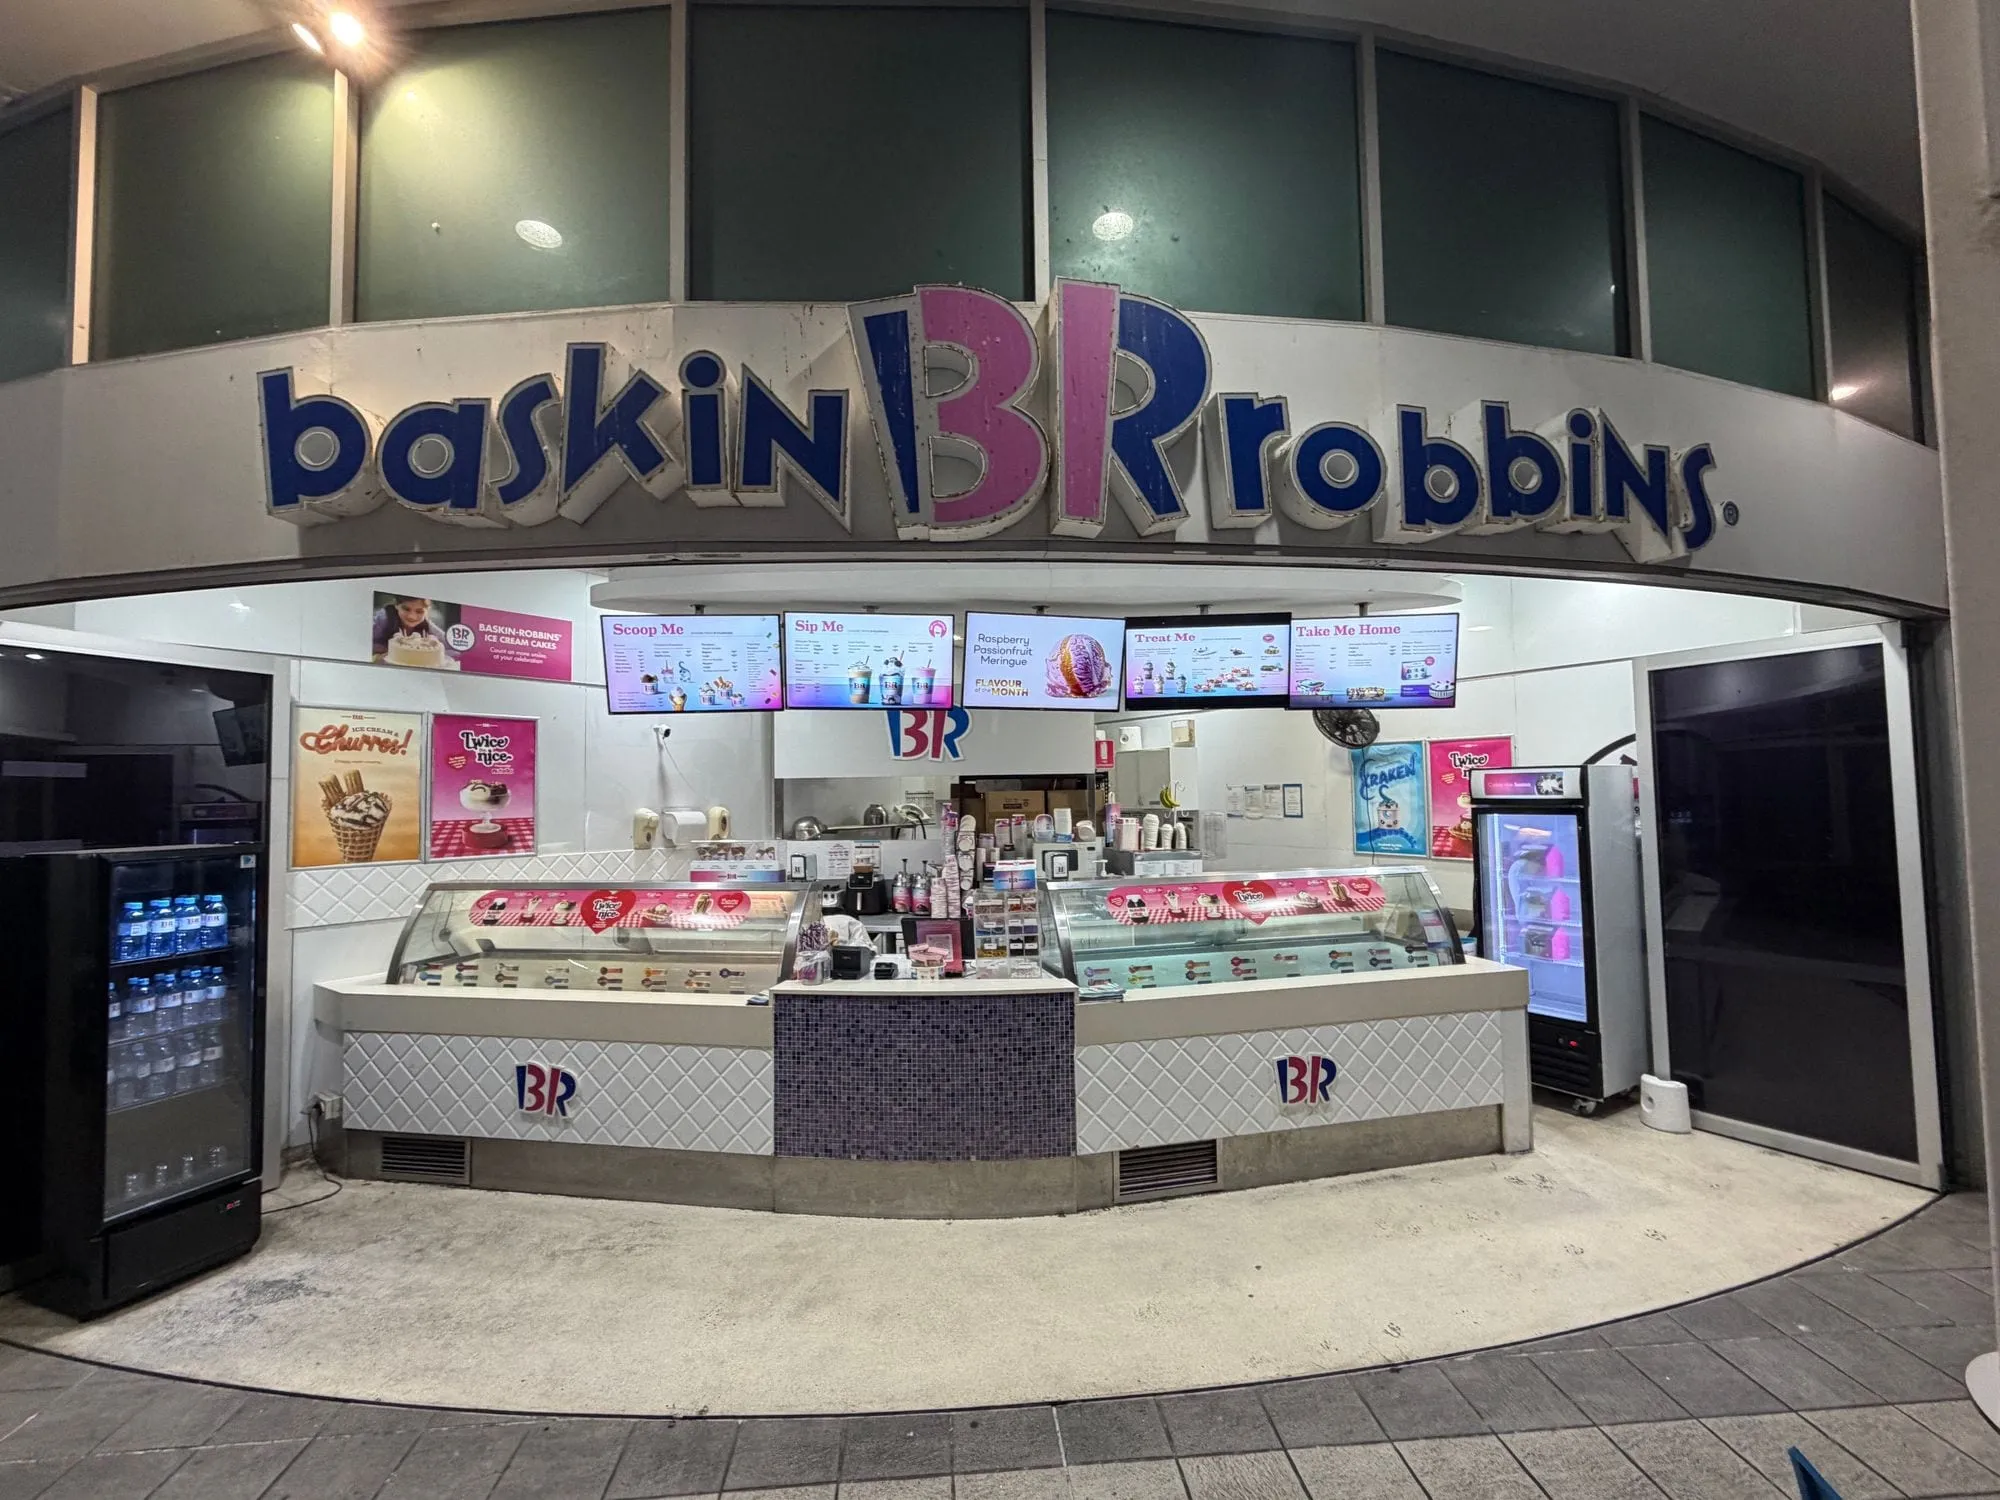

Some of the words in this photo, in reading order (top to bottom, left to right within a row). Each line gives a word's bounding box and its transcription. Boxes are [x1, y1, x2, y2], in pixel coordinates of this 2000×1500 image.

[850, 278, 1212, 525] BR
[613, 623, 657, 637] Scoop
[661, 624, 684, 635] Me
[795, 620, 818, 634] Sip
[822, 621, 844, 632] Me
[1296, 627, 1330, 636] Take
[1334, 625, 1355, 635] Me
[1359, 624, 1400, 635] Home
[452, 628, 470, 640] BR
[978, 633, 1030, 646] Raspberry
[1135, 634, 1172, 642] Treat
[1174, 633, 1196, 642] Me
[485, 634, 497, 642] ICE
[500, 636, 529, 646] CREAM
[531, 640, 557, 650] CAKES
[973, 645, 1033, 656] Passionfruit
[980, 656, 1028, 668] Meringue
[975, 679, 1022, 687] FLAVOUR
[991, 688, 1029, 697] MONTH
[366, 727, 393, 735] CREAM
[887, 707, 970, 759] BR
[460, 731, 509, 750] Twice
[477, 750, 513, 765] nice
[1450, 753, 1488, 768] Twice
[1235, 890, 1264, 903] Twice
[594, 899, 622, 911] Twice
[598, 910, 619, 920] nice
[1276, 1055, 1337, 1104] BR
[515, 1063, 577, 1117] BR
